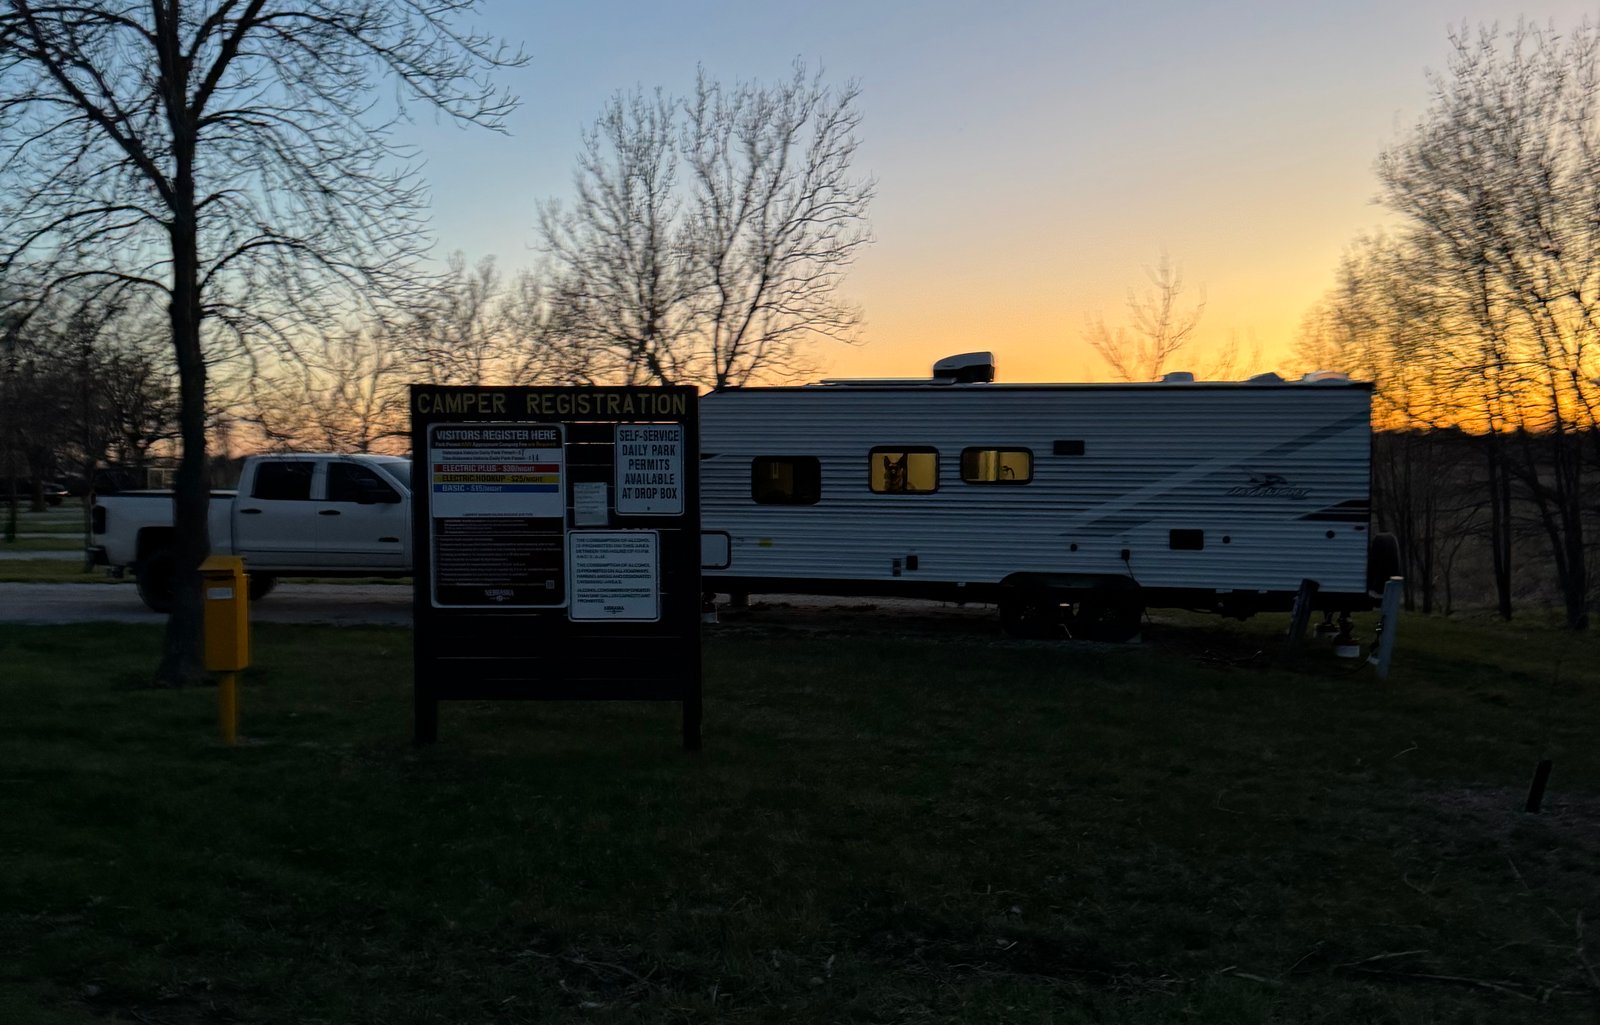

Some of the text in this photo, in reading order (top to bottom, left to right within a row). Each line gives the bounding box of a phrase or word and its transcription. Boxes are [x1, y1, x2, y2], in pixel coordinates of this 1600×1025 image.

[417, 393, 686, 414] CAMPER REGISTRATION
[436, 430, 557, 441] VISITORS REGISTER HERE
[620, 430, 680, 441] SELF-SERVICE
[622, 444, 676, 456] DAILY PARK
[442, 464, 476, 472] ELECTRIC
[477, 464, 497, 472] PLUS
[628, 459, 670, 470] PERMITS
[625, 473, 674, 485] AVAILABLE
[622, 487, 677, 499] AT DROP BOX
